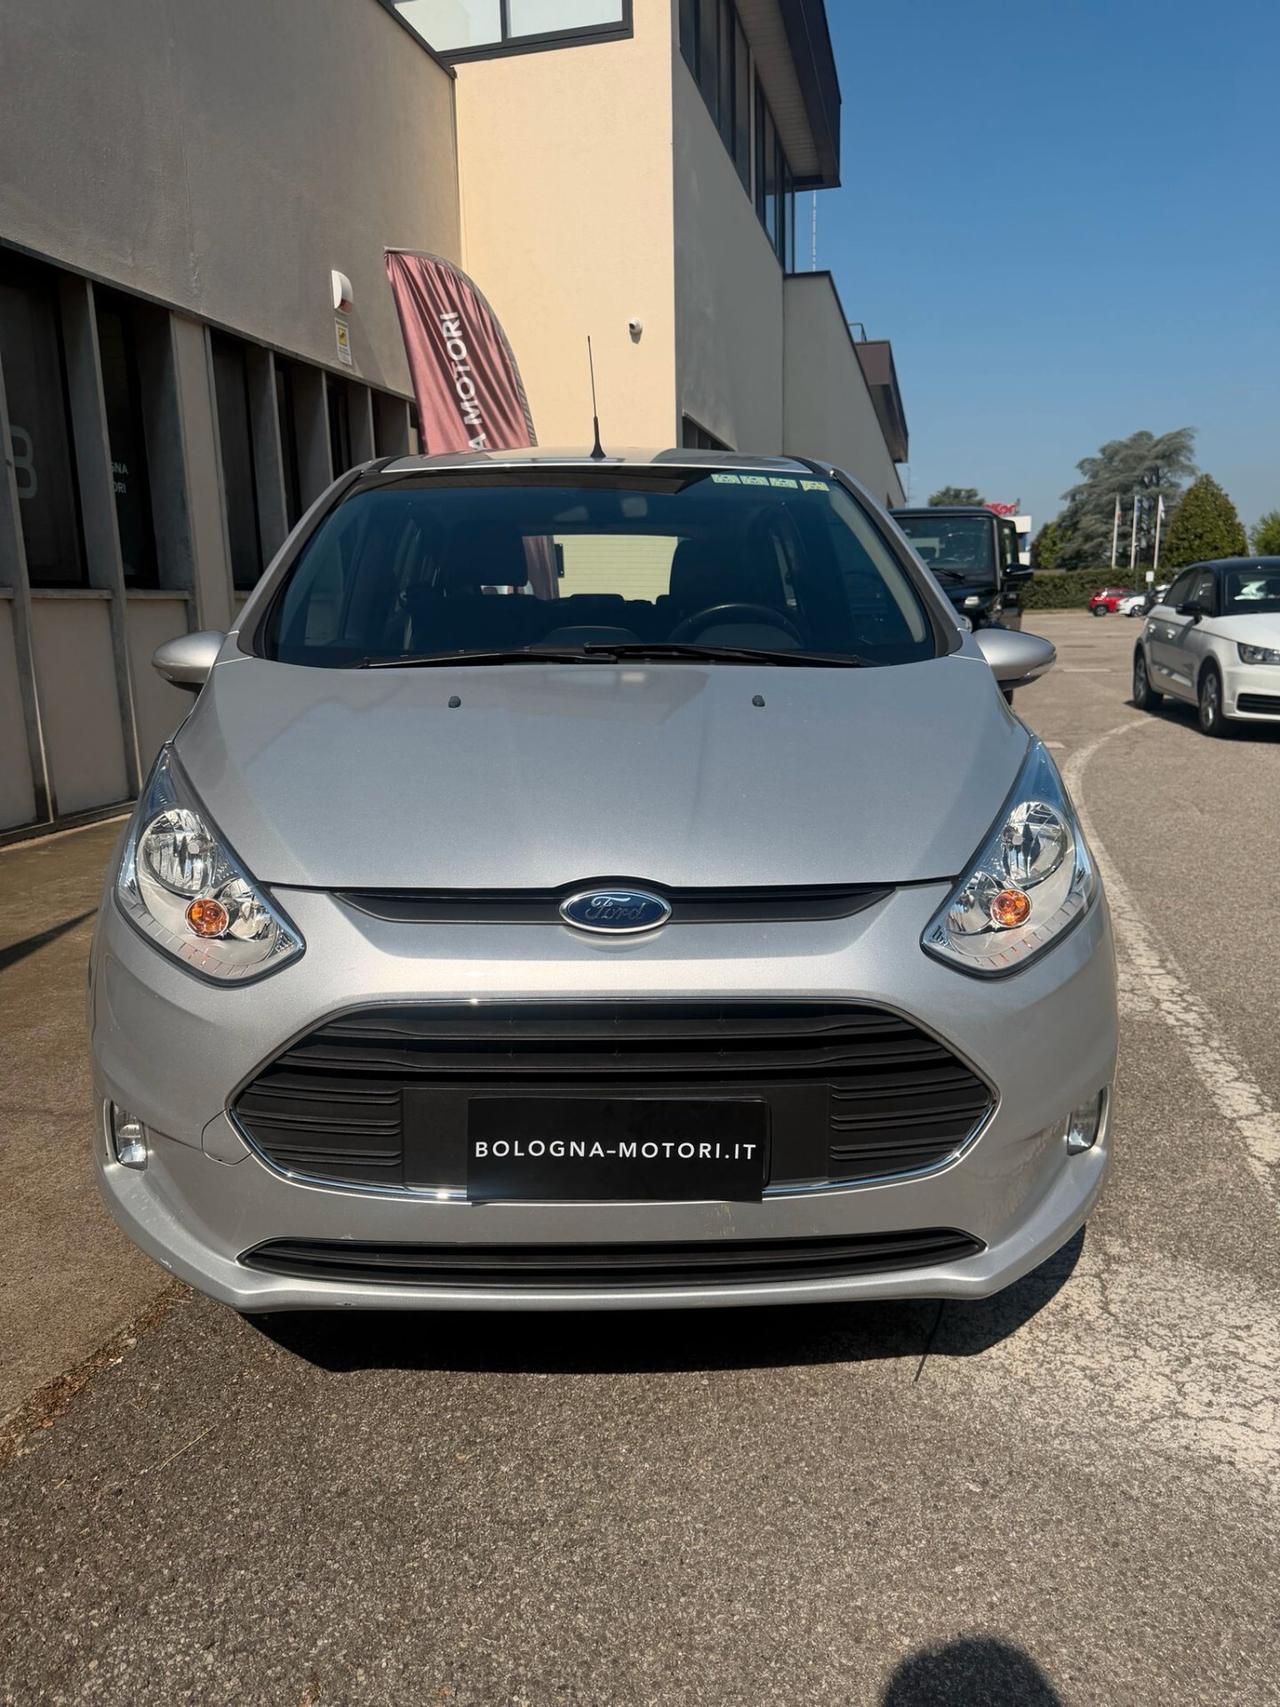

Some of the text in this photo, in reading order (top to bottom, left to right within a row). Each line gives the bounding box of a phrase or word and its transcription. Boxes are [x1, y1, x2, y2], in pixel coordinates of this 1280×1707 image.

[440, 311, 482, 425] MOTORI
[585, 896, 646, 920] Ford
[475, 1140, 757, 1160] BOLOGNA-MOTORI.IT
